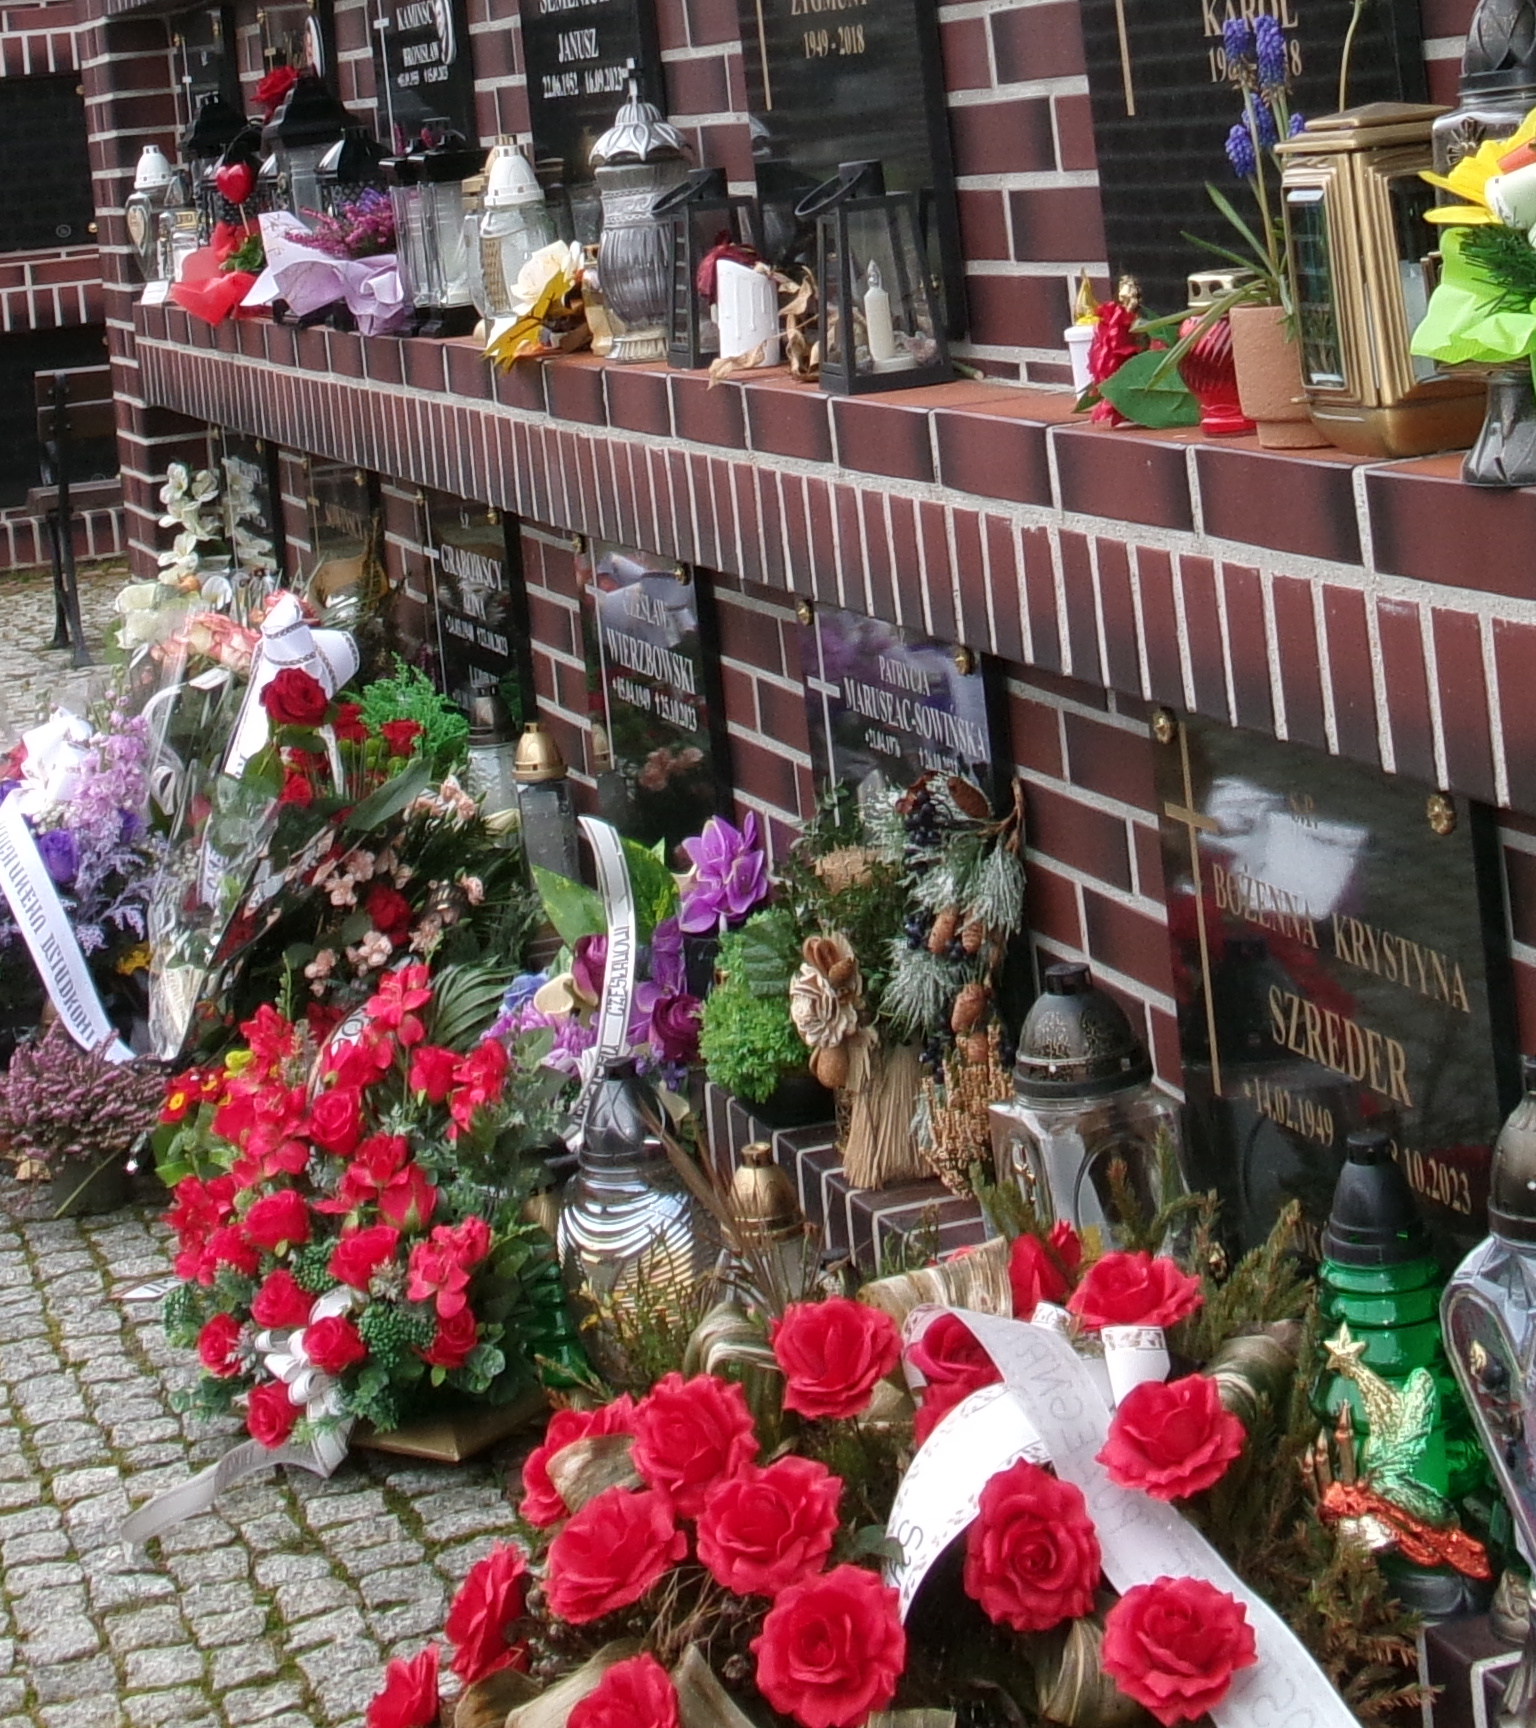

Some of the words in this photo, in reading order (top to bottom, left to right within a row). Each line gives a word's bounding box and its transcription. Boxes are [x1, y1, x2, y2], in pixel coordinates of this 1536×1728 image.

[558, 27, 600, 64] JANUSZ
[803, 28, 830, 59] 1949
[837, 23, 866, 56] 2018
[605, 626, 697, 696] WIERZBOWSKI
[878, 654, 932, 698] PATRYCJA
[1212, 862, 1320, 950] BOŻENNA
[1331, 911, 1471, 1014] KRYSTYNA
[1269, 984, 1413, 1108] SZREDER
